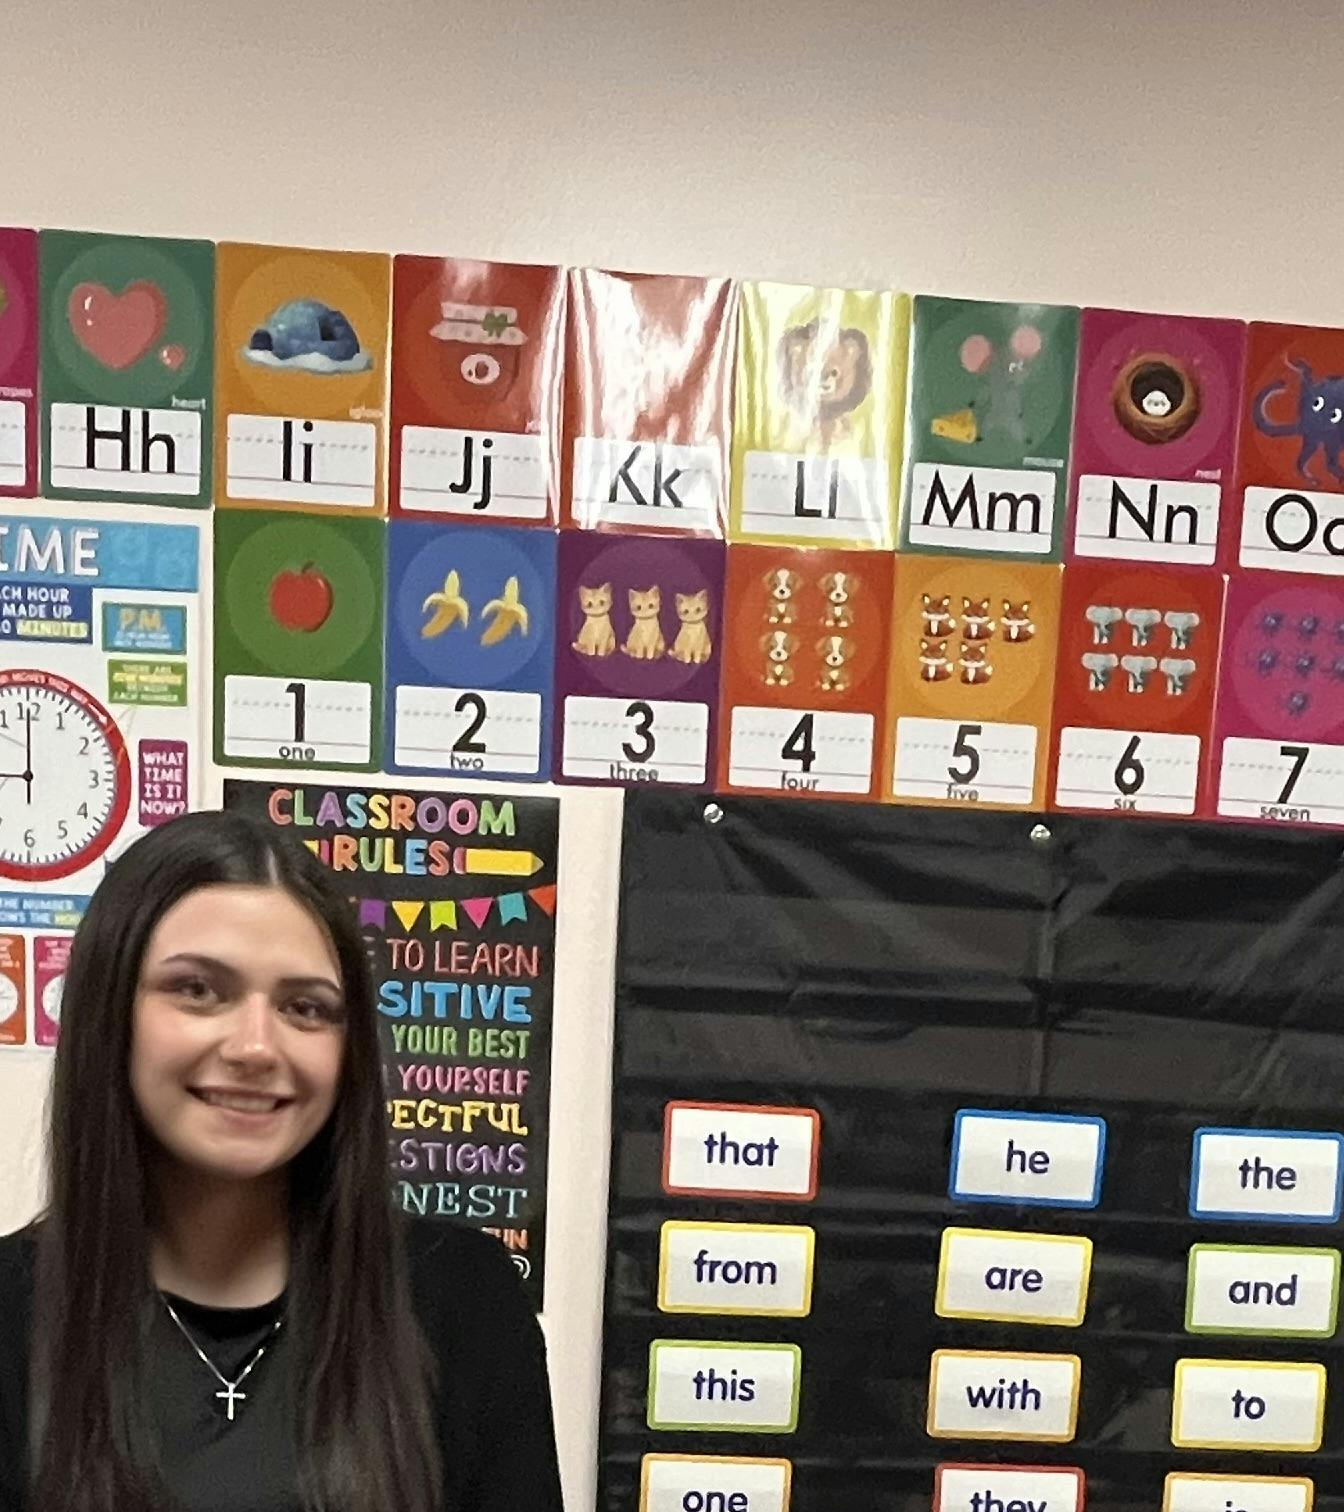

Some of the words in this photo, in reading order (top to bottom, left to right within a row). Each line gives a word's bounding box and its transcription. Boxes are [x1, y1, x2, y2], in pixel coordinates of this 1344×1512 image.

[85, 408, 175, 473] Hh
[450, 439, 492, 510] Jj
[612, 445, 682, 508] Kk
[795, 462, 837, 519] Ll
[923, 471, 1040, 533] Mm
[1109, 482, 1197, 544] Nn
[2, 603, 46, 618] MADE
[53, 605, 72, 619] UP
[27, 586, 69, 602] HOUR
[17, 621, 88, 638] MINUTES
[285, 682, 306, 742] 1
[454, 693, 486, 753] 2
[623, 702, 655, 763] 3
[783, 714, 815, 773] 4
[143, 753, 183, 767] WHAT
[279, 745, 314, 761] one
[450, 753, 483, 771] two
[948, 726, 982, 785] 5
[1115, 735, 1144, 795] 6
[143, 769, 182, 784] TIME
[610, 762, 658, 782] three
[781, 774, 819, 792] four
[1279, 747, 1309, 803] 7
[140, 801, 187, 815] NOW?
[143, 785, 162, 799] IS
[267, 789, 515, 836] CLASSROOM
[1260, 805, 1309, 822] seven
[334, 837, 451, 877] RULES
[387, 938, 424, 971] TO
[435, 940, 539, 976] LEARN
[376, 981, 531, 1023] SITIVE
[392, 1025, 456, 1055] YOUR
[468, 1026, 529, 1059] BEST
[399, 1065, 529, 1095] YOURSELF
[389, 1101, 527, 1135] ECTFUL
[399, 1141, 526, 1175] STIONS
[703, 1132, 779, 1168] that
[1005, 1140, 1050, 1175] he
[1239, 1158, 1296, 1190] the
[399, 1182, 527, 1218] NEST
[694, 1252, 776, 1285] from
[984, 1264, 1043, 1294] are
[1228, 1276, 1298, 1308] and
[694, 1368, 755, 1403] this
[966, 1378, 1042, 1412] with
[1232, 1391, 1266, 1421] to
